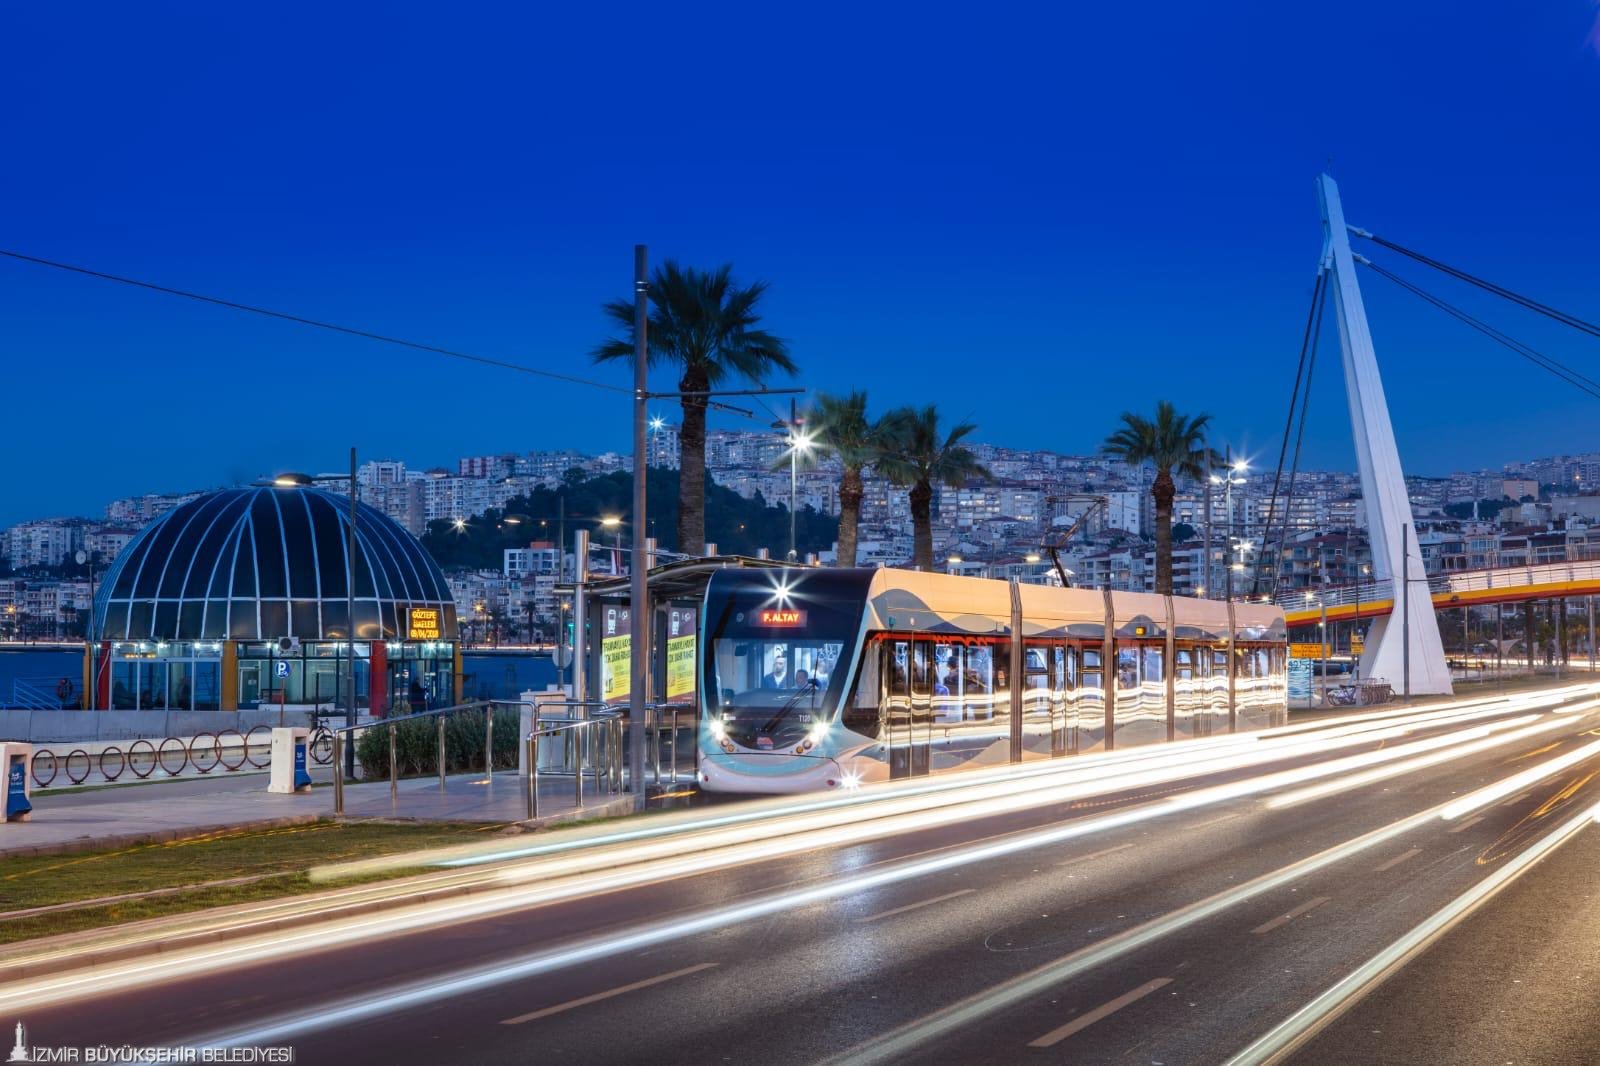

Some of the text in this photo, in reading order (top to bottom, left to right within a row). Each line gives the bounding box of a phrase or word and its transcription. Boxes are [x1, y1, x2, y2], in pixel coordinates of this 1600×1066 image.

[412, 609, 438, 619] GÖZTEPE
[763, 613, 799, 623] F.ALTAY
[277, 662, 287, 676] P
